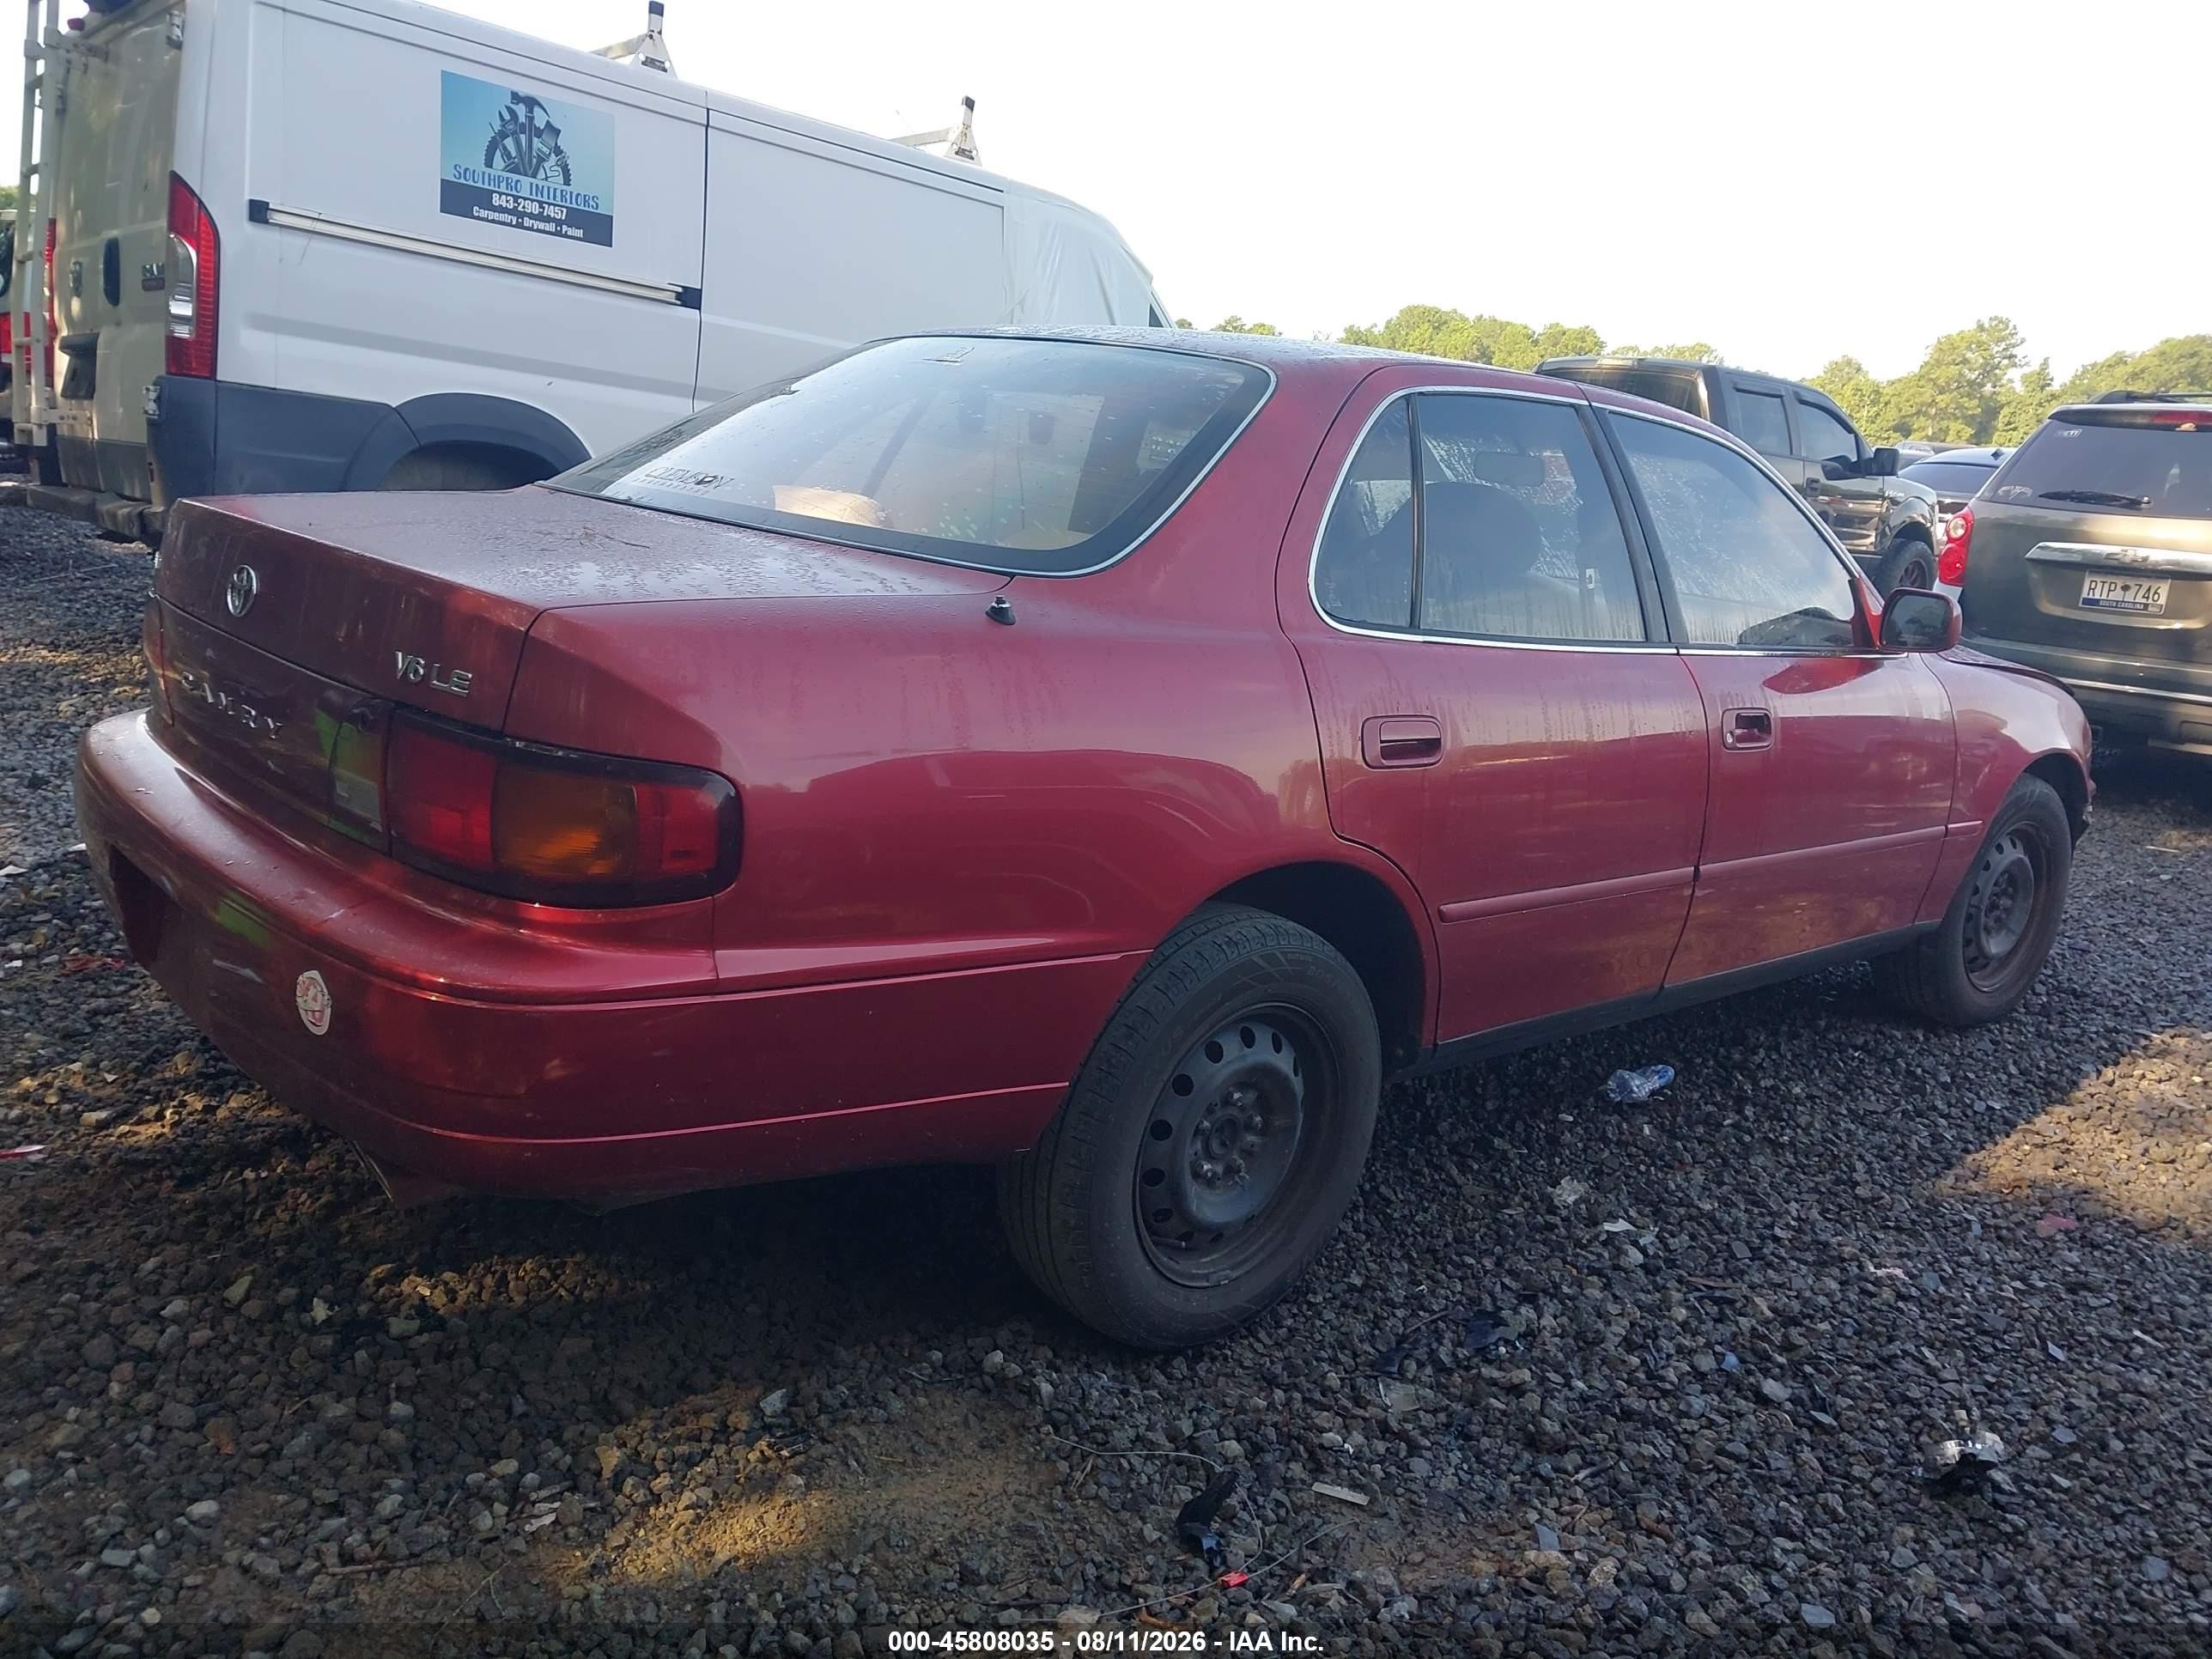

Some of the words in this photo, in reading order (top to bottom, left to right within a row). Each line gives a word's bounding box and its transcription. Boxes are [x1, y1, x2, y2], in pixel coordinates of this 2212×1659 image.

[453, 164, 522, 194] SOUTHPRO
[529, 181, 599, 210] INTERIORS
[473, 205, 518, 226] Carpentry
[523, 216, 556, 233] Drywall
[562, 224, 584, 239] Paint
[492, 193, 567, 221] 843-290-7457
[2087, 580, 2118, 599] RTP
[2133, 584, 2161, 603] 746
